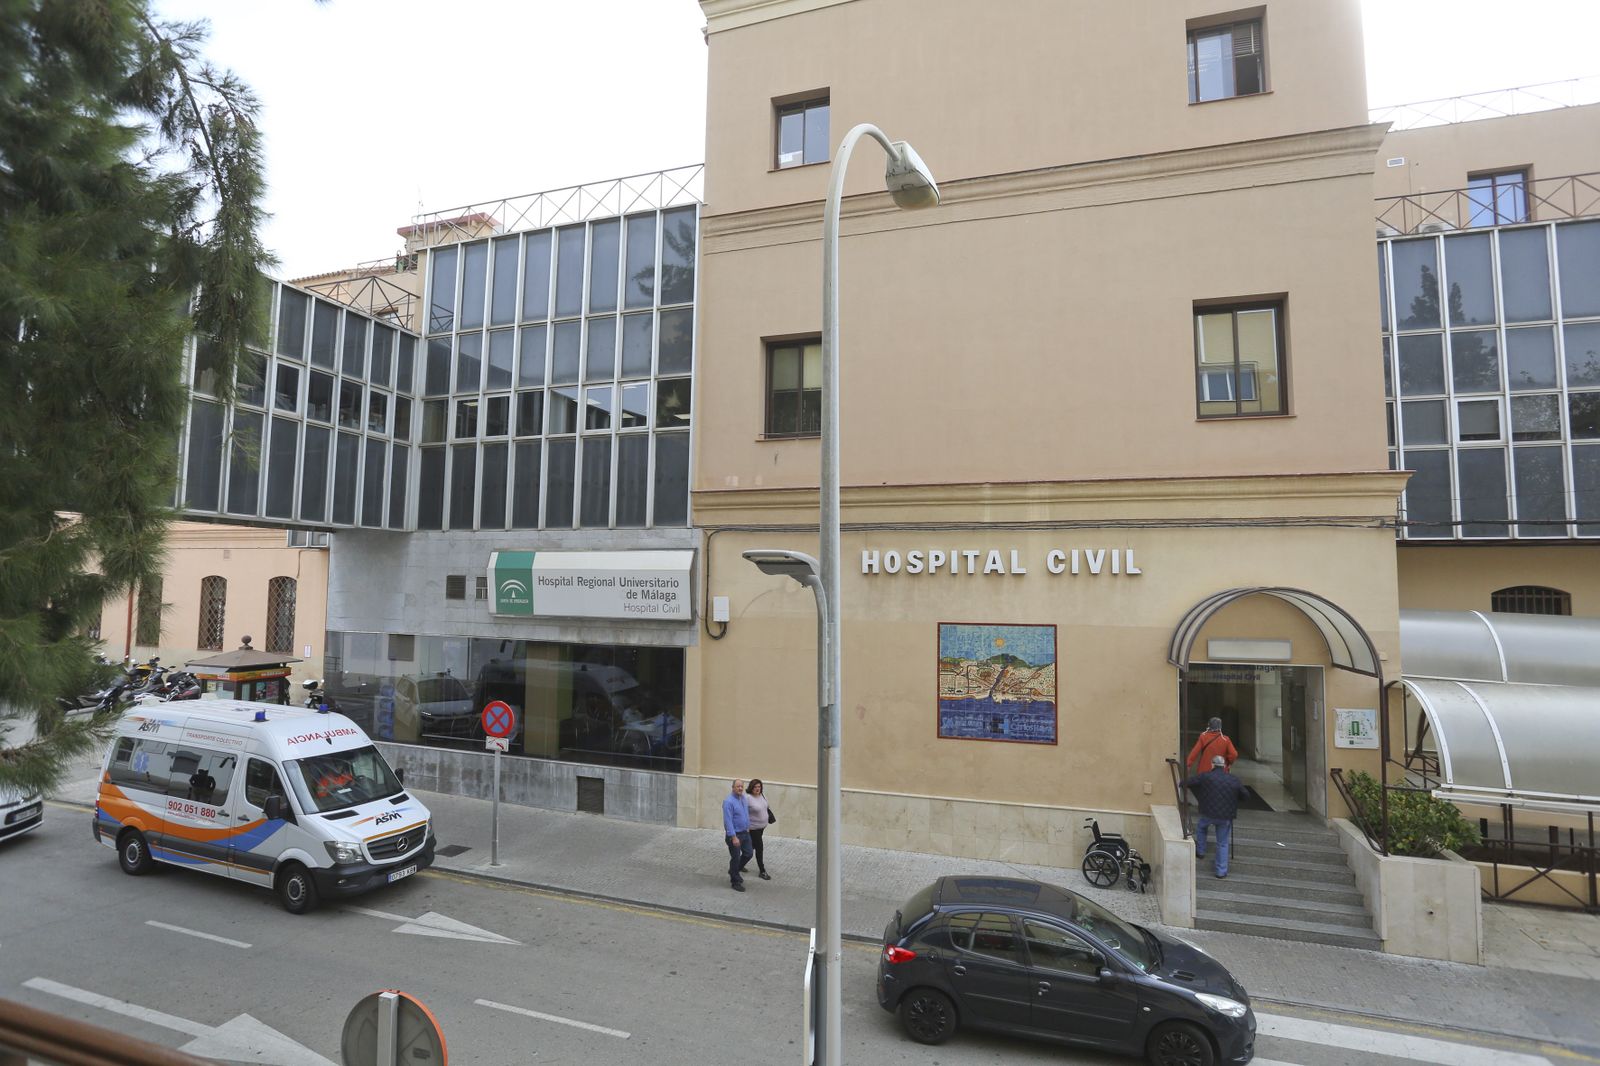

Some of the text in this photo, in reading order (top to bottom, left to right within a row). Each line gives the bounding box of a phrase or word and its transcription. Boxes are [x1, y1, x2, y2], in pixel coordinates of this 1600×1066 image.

[861, 549, 1142, 575] HOSPITAL CIVIL
[538, 576, 680, 590] Hospital Regional Universitario
[626, 589, 677, 602] de Málaga
[623, 603, 681, 615] Hospital Civil
[138, 721, 161, 733] ASM
[186, 732, 243, 746] TRANSPORTE COLECTIVO
[168, 800, 183, 812] 902
[184, 804, 198, 815] 051
[200, 807, 216, 819] 880
[375, 812, 402, 826] ASM
